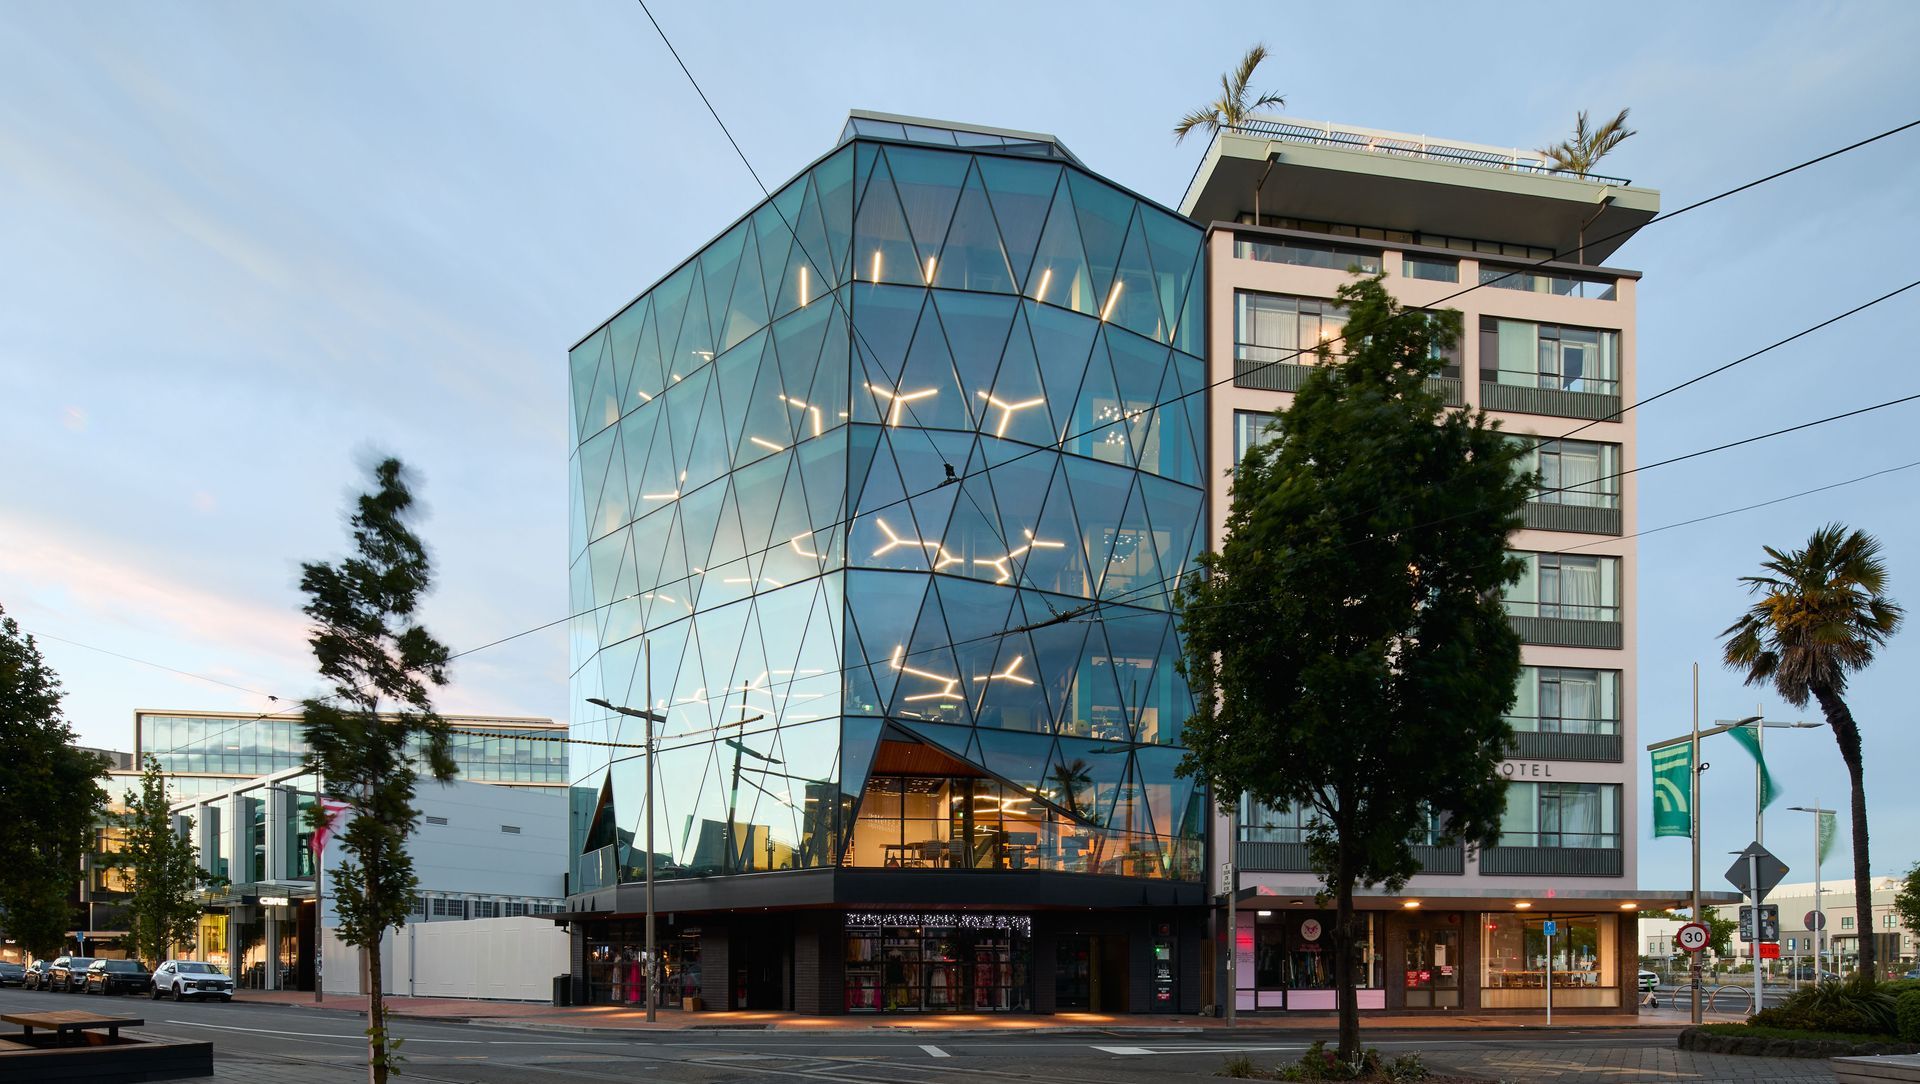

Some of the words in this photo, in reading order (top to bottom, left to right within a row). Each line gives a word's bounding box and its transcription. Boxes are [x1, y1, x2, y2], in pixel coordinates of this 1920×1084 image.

[1502, 763, 1552, 777] OTEL
[259, 896, 289, 906] CBRE
[1684, 931, 1703, 944] 30
